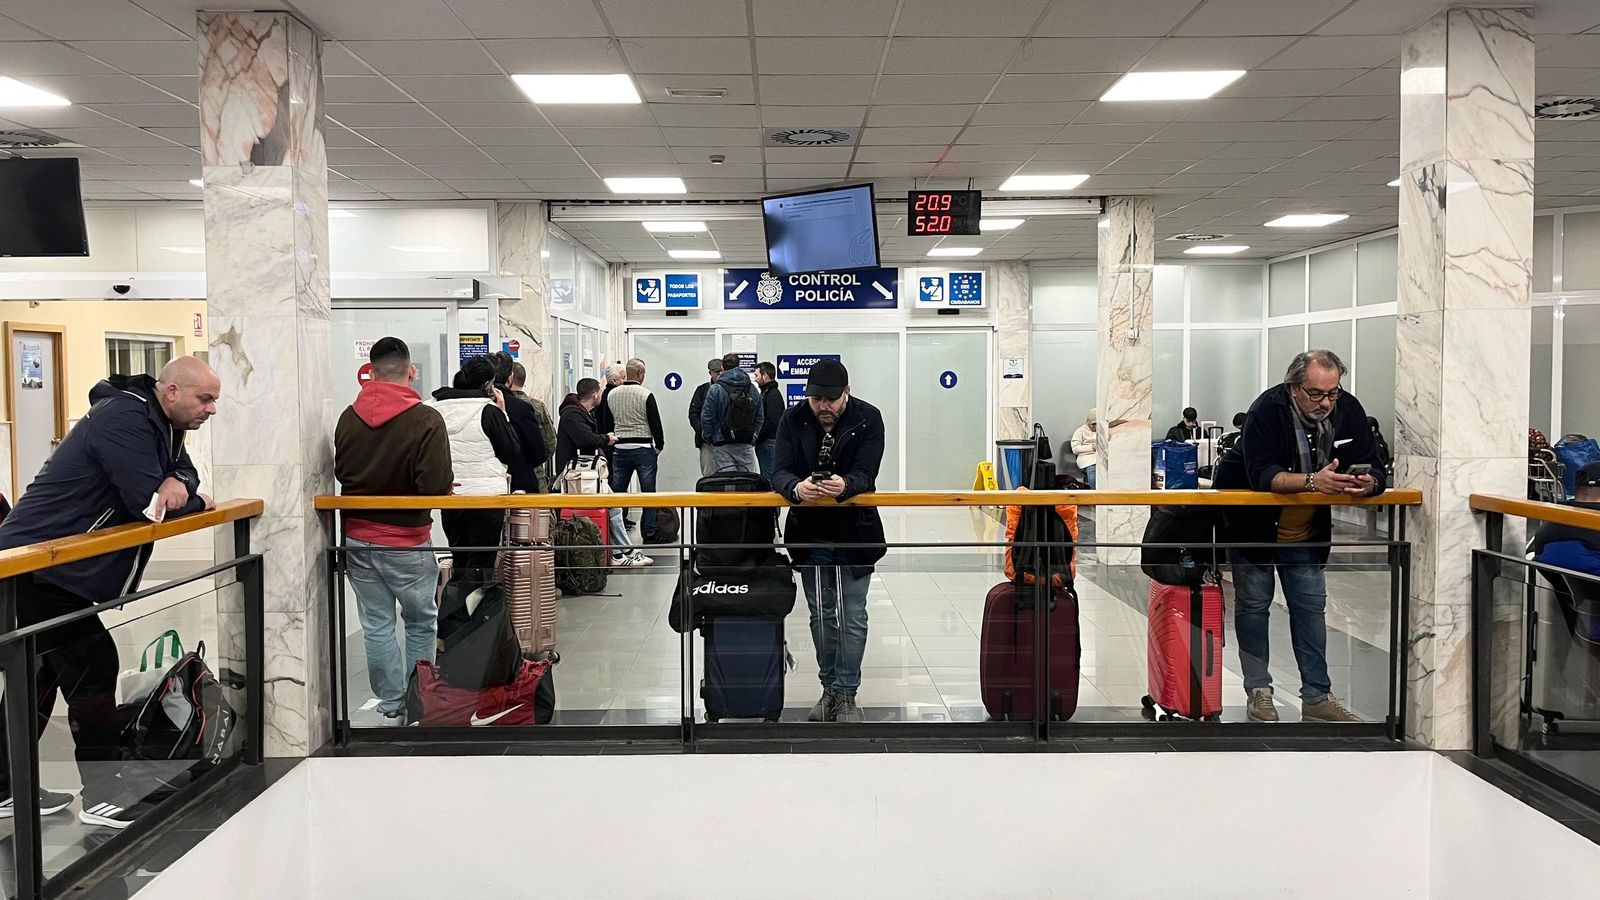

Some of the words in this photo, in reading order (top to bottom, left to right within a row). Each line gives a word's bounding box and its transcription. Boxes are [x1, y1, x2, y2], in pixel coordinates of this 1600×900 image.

[915, 195, 952, 210] 20.9
[915, 216, 951, 232] 52.0
[788, 274, 862, 286] CONTROL
[795, 287, 855, 302] POLICÍA
[692, 581, 749, 596] adidas
